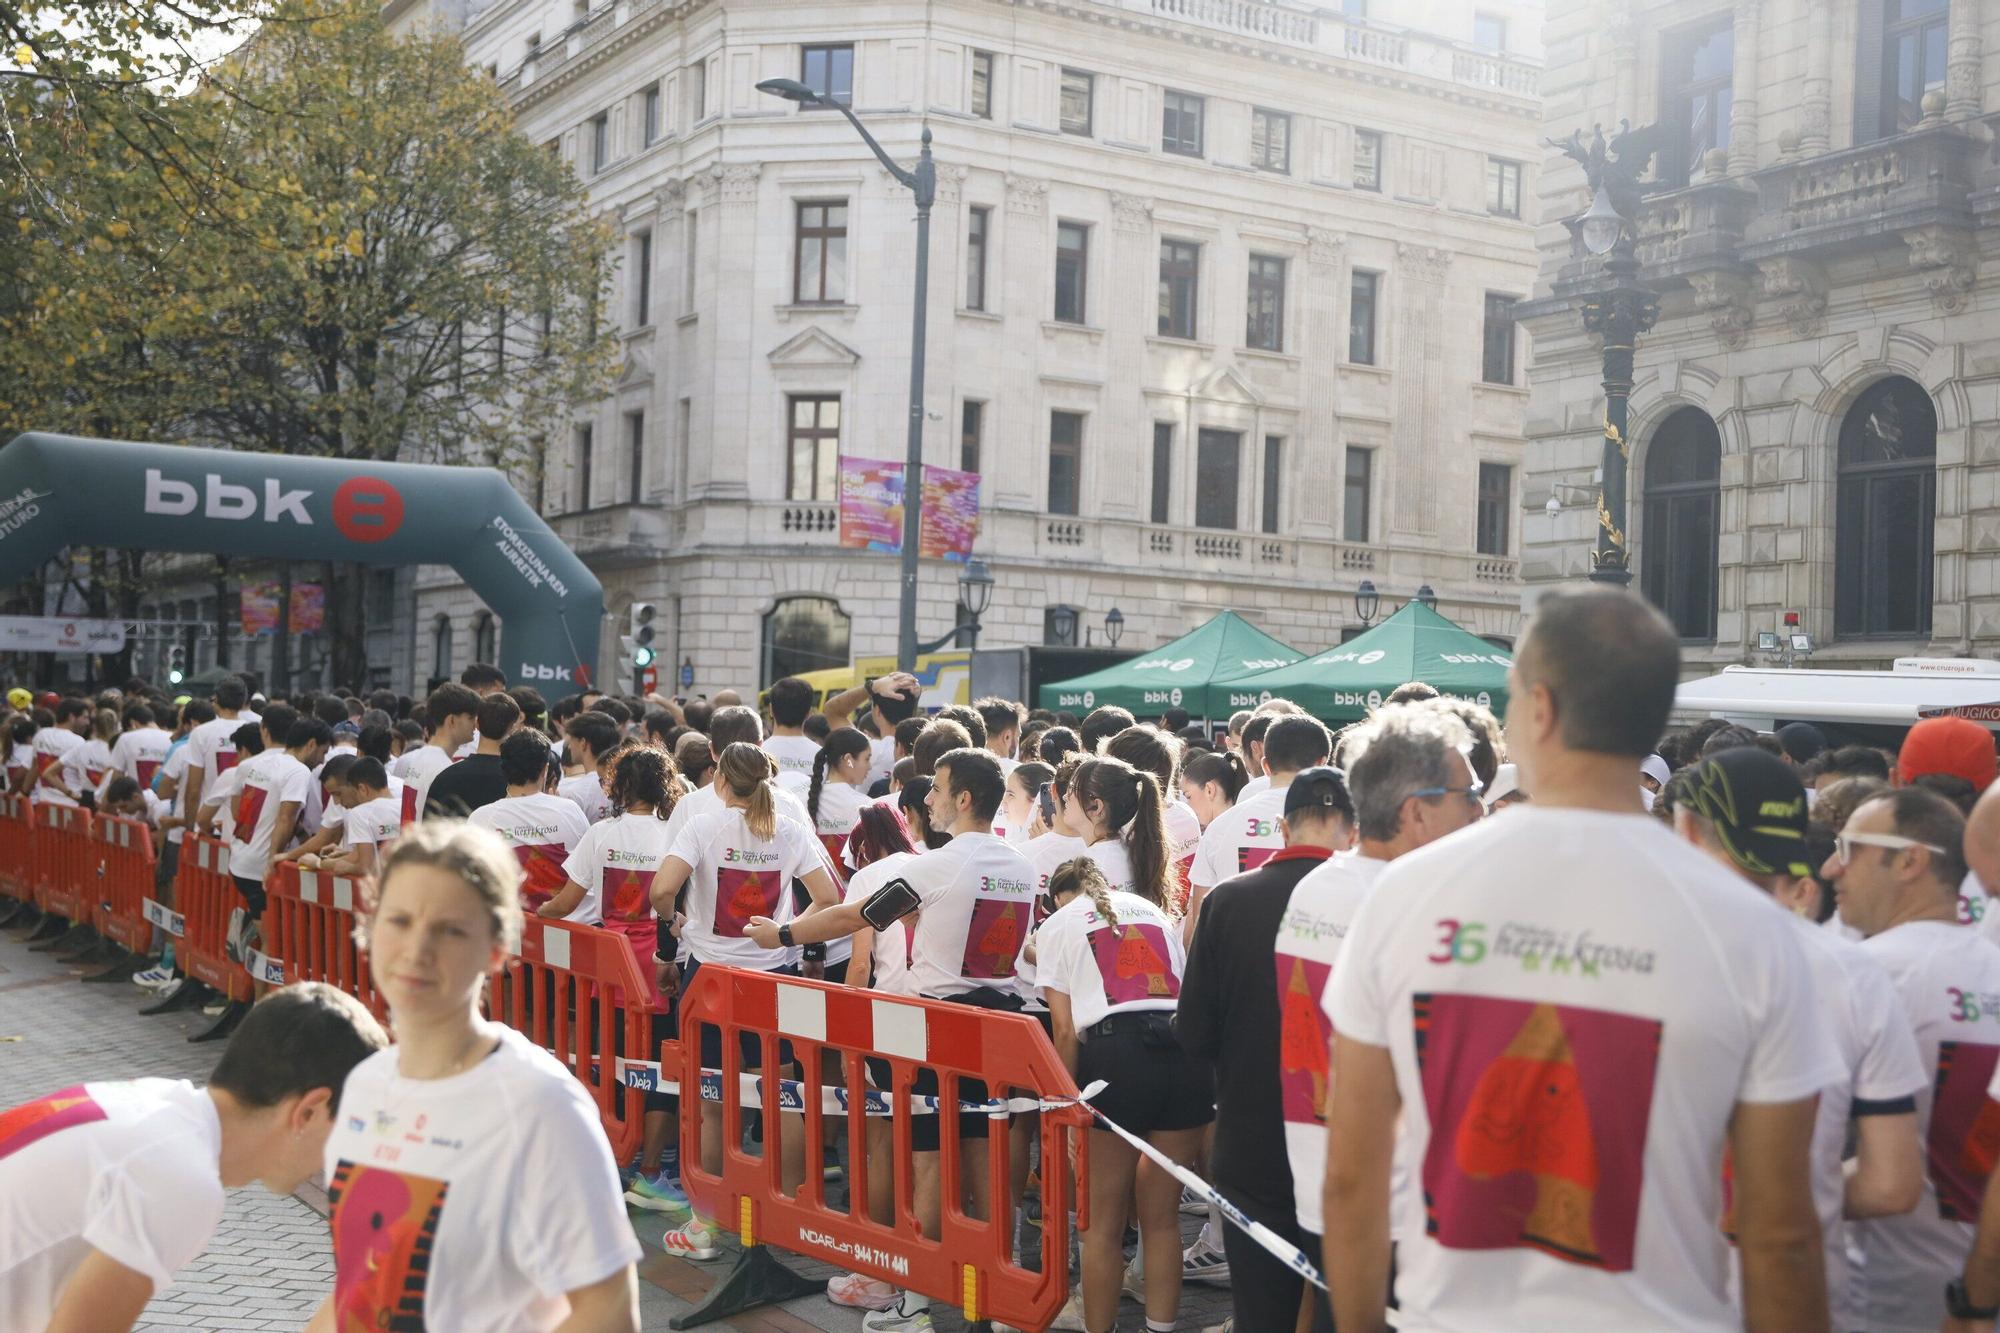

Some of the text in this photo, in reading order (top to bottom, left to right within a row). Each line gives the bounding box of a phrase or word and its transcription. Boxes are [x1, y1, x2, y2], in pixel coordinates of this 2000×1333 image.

[145, 468, 313, 525] bbk
[494, 516, 568, 597] ETORKIZUNAREN
[496, 540, 543, 588] AURRETIK
[521, 662, 571, 681] bbk
[1059, 694, 1082, 706] bbk
[1144, 691, 1169, 704] bbk
[1231, 693, 1257, 706] bbk
[1335, 692, 1364, 706] bbk
[379, 825, 391, 835] 36
[1246, 819, 1271, 837] 36
[607, 849, 621, 861] 36
[725, 848, 741, 861] 36
[980, 876, 996, 891] 36
[1957, 895, 1985, 925] 36
[1428, 919, 1488, 966] 36
[1946, 987, 1980, 1022] 36
[701, 1079, 719, 1100] eia
[854, 1243, 872, 1263] 944
[873, 1250, 889, 1269] 711
[892, 1255, 909, 1276] 441
